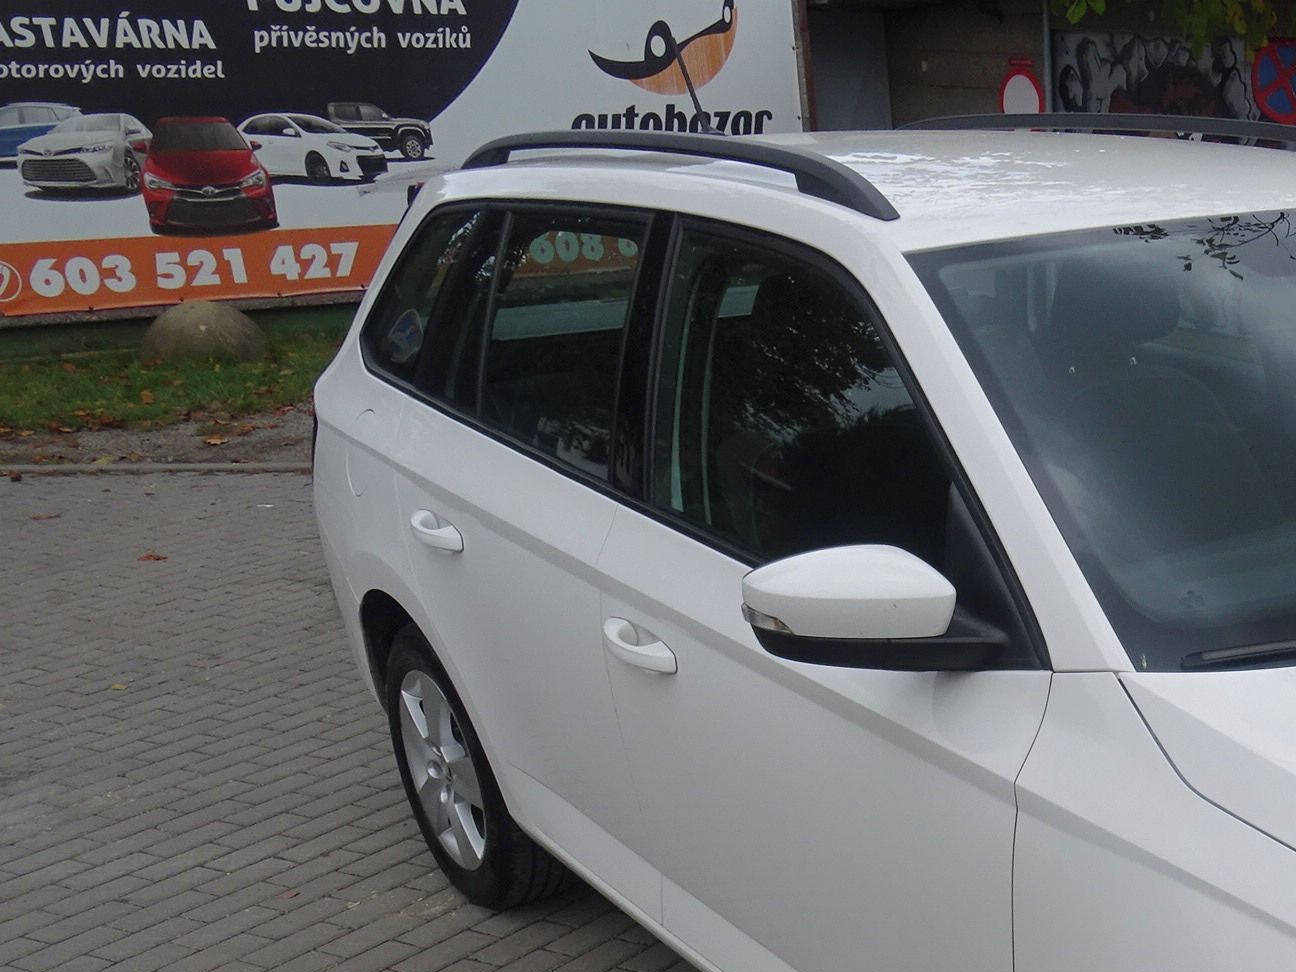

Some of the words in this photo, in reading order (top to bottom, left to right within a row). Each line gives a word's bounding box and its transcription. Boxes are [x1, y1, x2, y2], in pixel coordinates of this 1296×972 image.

[254, 25, 387, 54] přívěsných
[397, 25, 472, 49] vozíků
[136, 60, 226, 79] vozidel
[29, 254, 138, 298] 603
[155, 248, 248, 290] 521
[269, 242, 359, 281] 427
